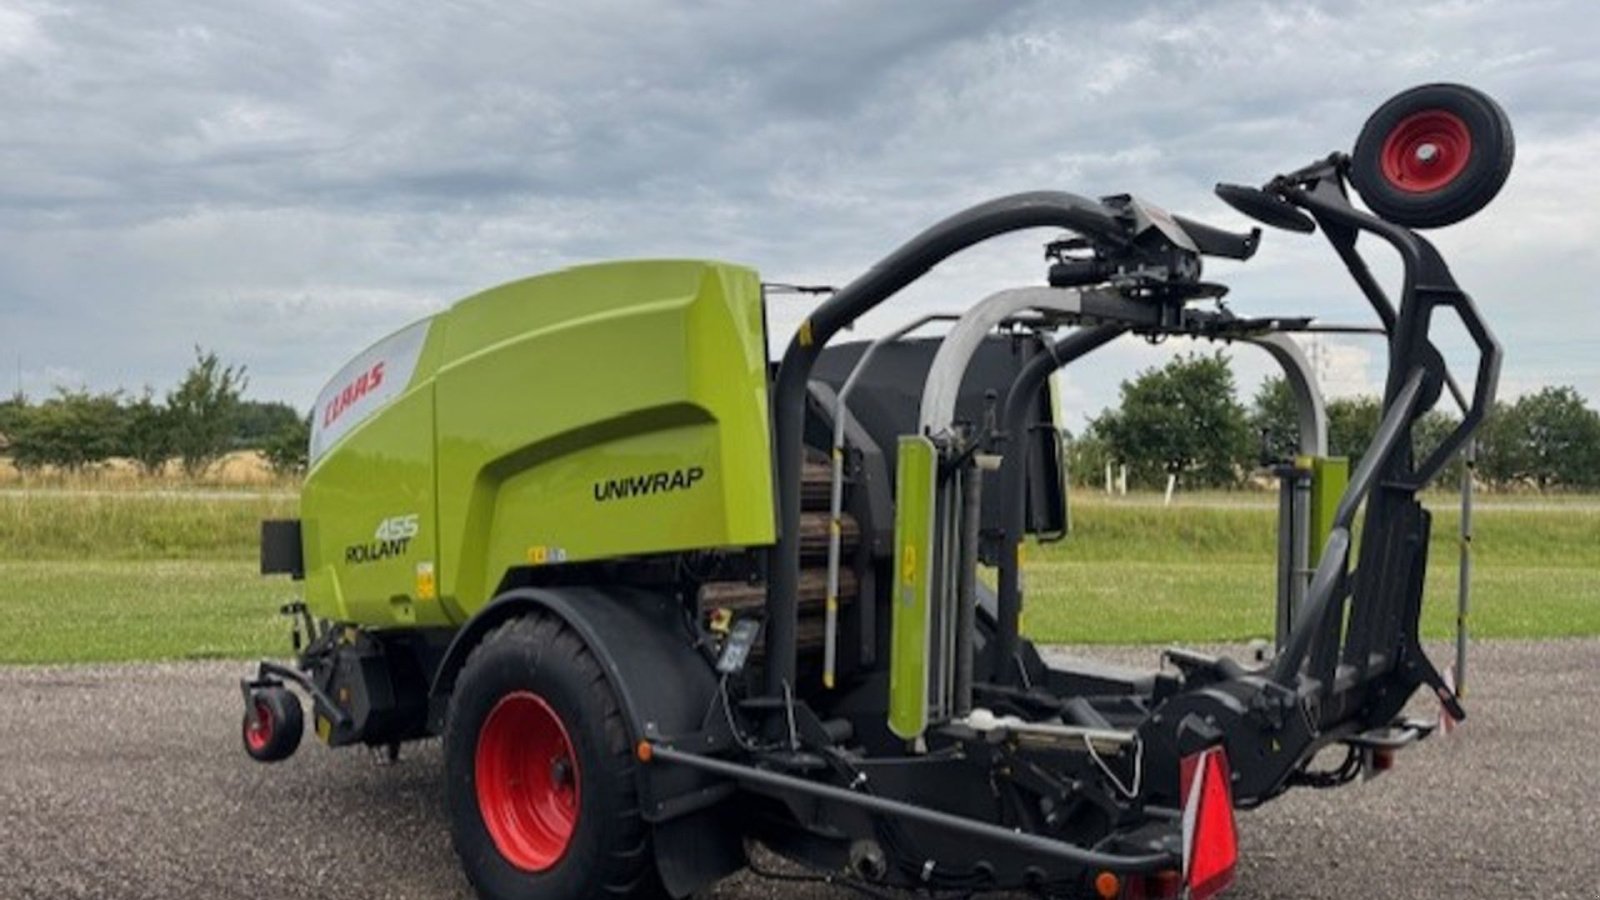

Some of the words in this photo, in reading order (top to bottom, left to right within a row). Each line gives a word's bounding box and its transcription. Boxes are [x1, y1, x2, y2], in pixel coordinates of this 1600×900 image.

[323, 362, 385, 429] CLAAS
[594, 467, 704, 501] UNIWRAP
[375, 514, 419, 540] 455
[345, 537, 410, 564] ROLLANT
